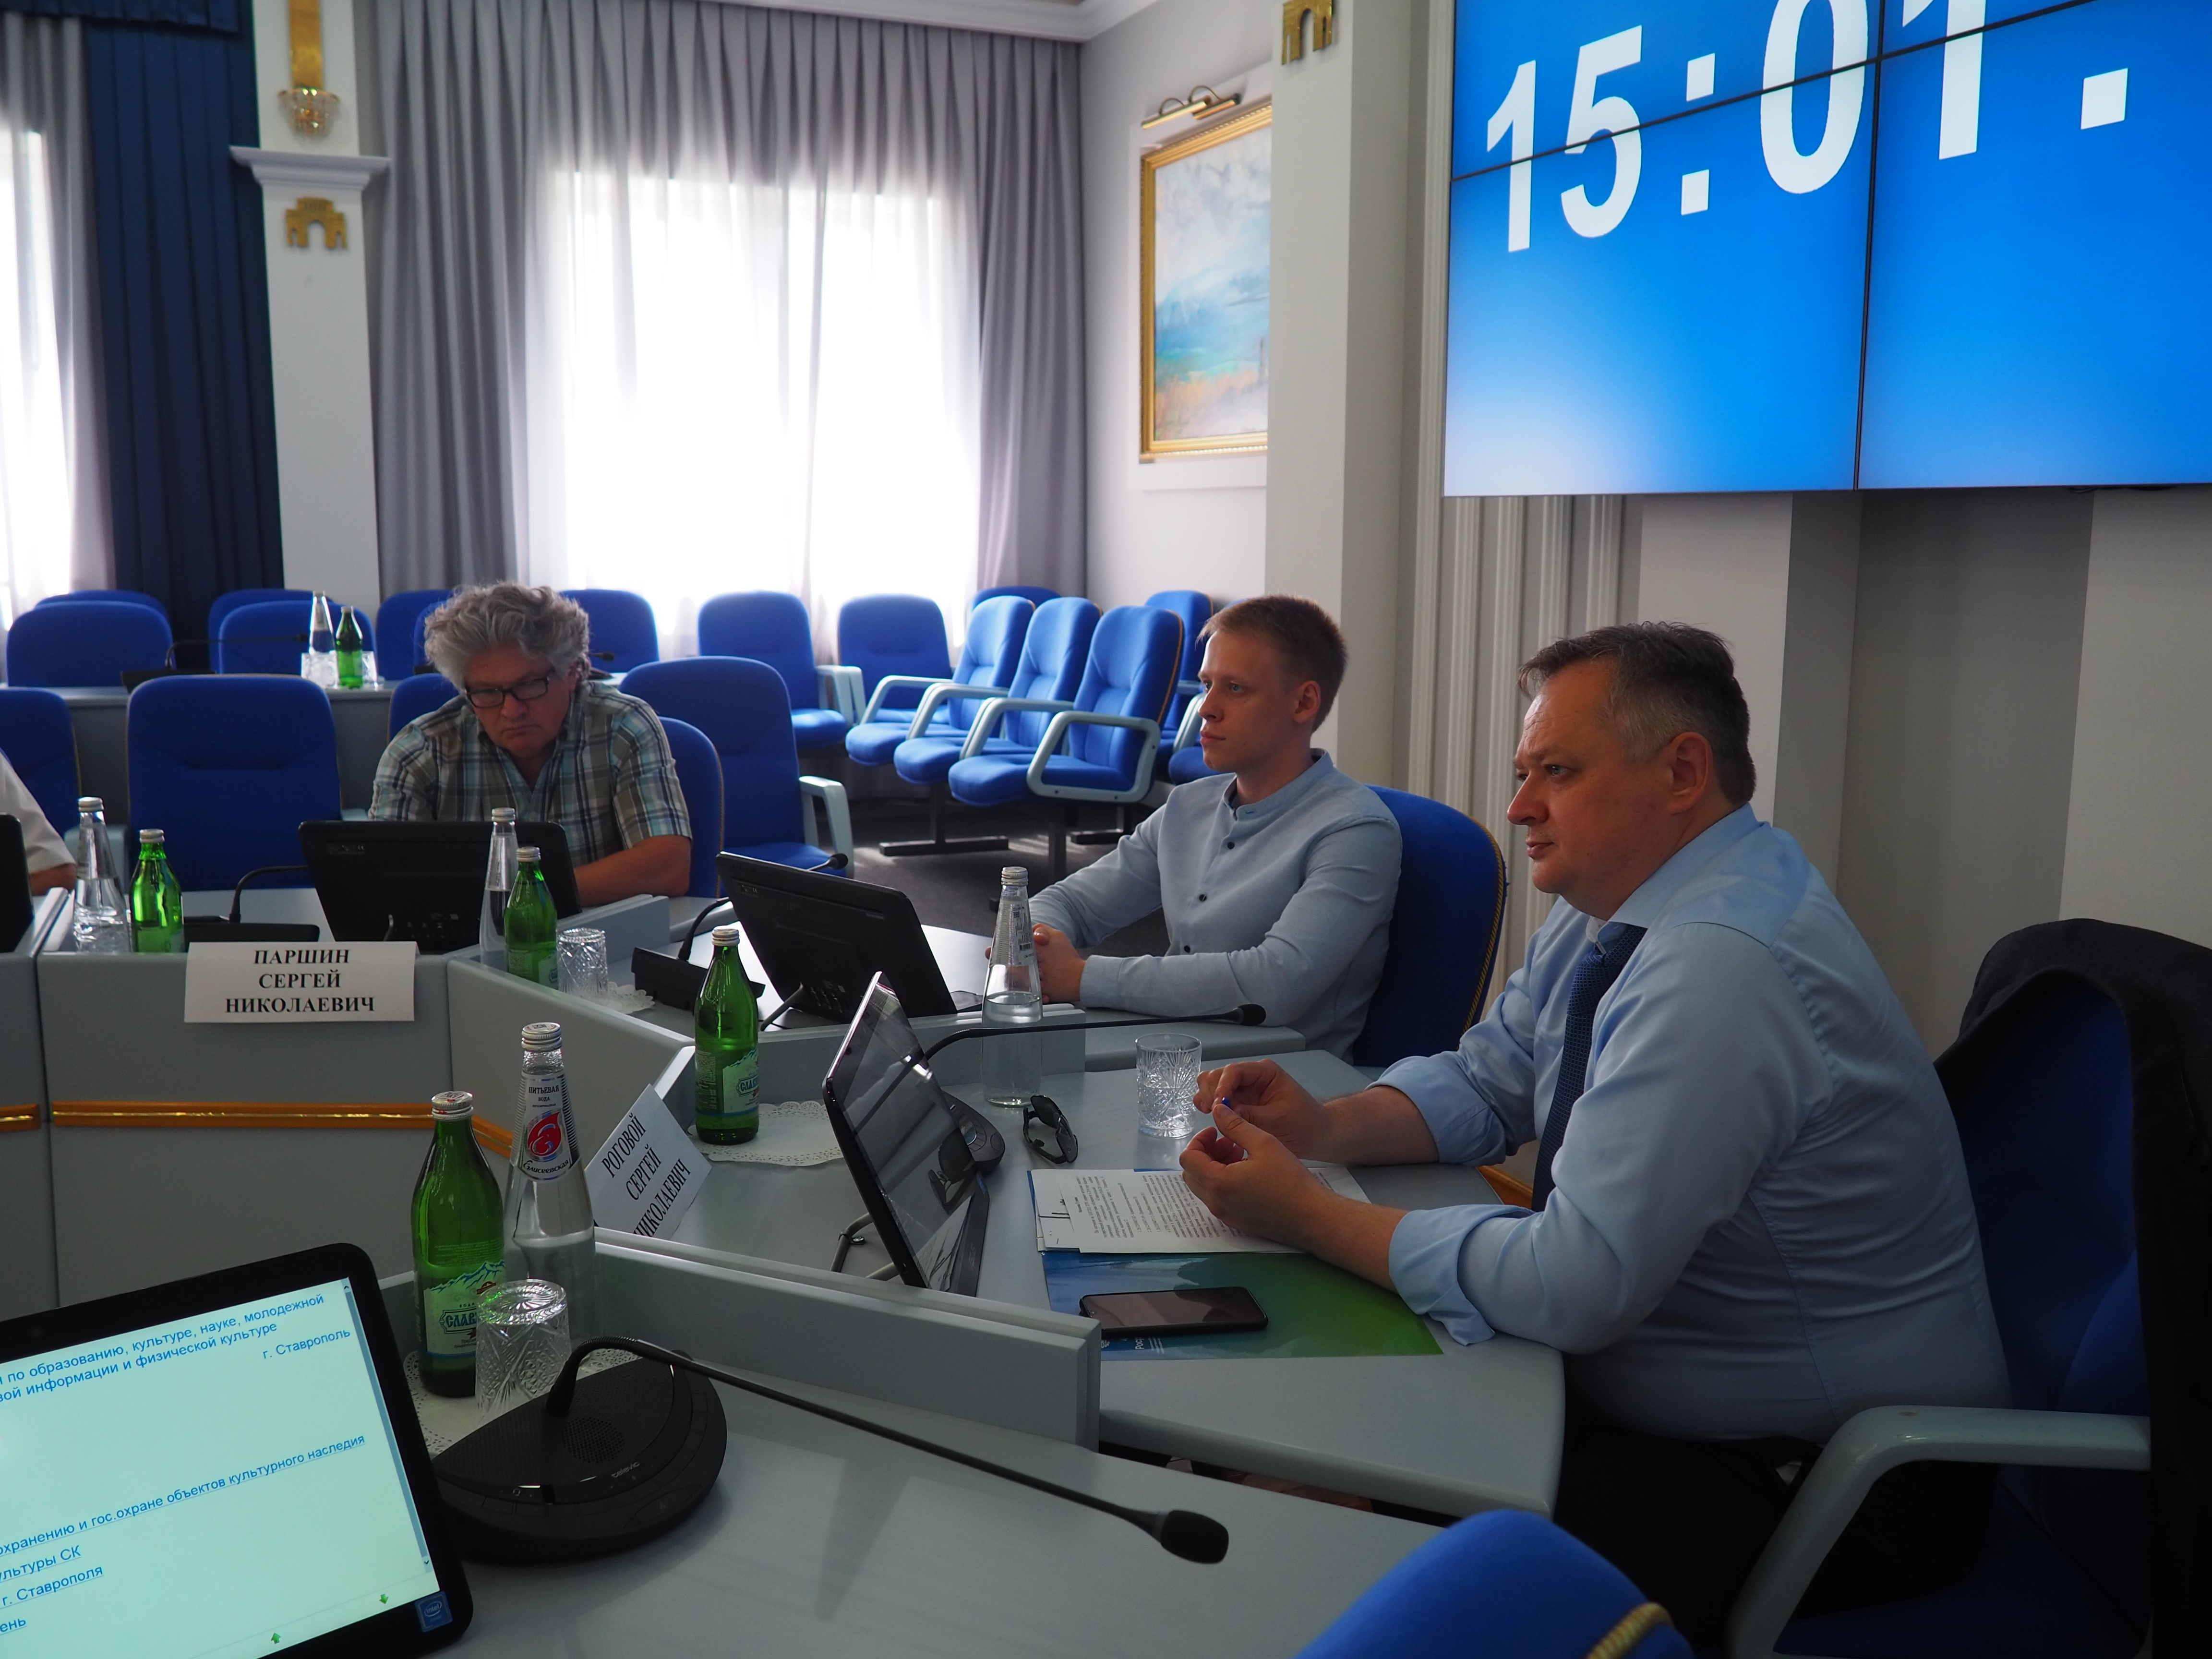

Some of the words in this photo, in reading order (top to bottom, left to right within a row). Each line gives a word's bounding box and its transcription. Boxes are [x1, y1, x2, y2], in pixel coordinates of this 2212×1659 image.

[253, 949, 350, 964] ПАРШИН
[259, 969, 341, 988] СЕРГЕЙ
[225, 997, 374, 1013] НИКОЛАЕВИЧ
[529, 1085, 560, 1094] ПИТЬЕВАЯ
[601, 1112, 646, 1178] РОГОВОЙ
[523, 1159, 569, 1173] Елисеевская
[626, 1143, 661, 1201] СЕРГЕЙ
[8, 1371, 24, 1382] по
[29, 1346, 129, 1377] образованию,
[132, 1328, 197, 1352] культуре,
[200, 1318, 241, 1334] науке,
[244, 1294, 324, 1323] молодежной
[263, 1349, 273, 1359] г.
[276, 1329, 351, 1355] Ставрополь
[26, 1363, 119, 1395] информации
[122, 1360, 132, 1370] и
[135, 1336, 217, 1368] физической
[220, 1323, 277, 1346] культуре
[611, 1462, 640, 1478] televic
[79, 1521, 87, 1530] и
[91, 1496, 163, 1526] гос.охране
[167, 1478, 226, 1503] объектов
[229, 1454, 305, 1484] культурного
[308, 1435, 365, 1460] наследия
[60, 1545, 82, 1561] СК
[2, 1596, 12, 1606] г.
[17, 1566, 103, 1600] Ставрополя
[0, 1619, 26, 1632] ень
